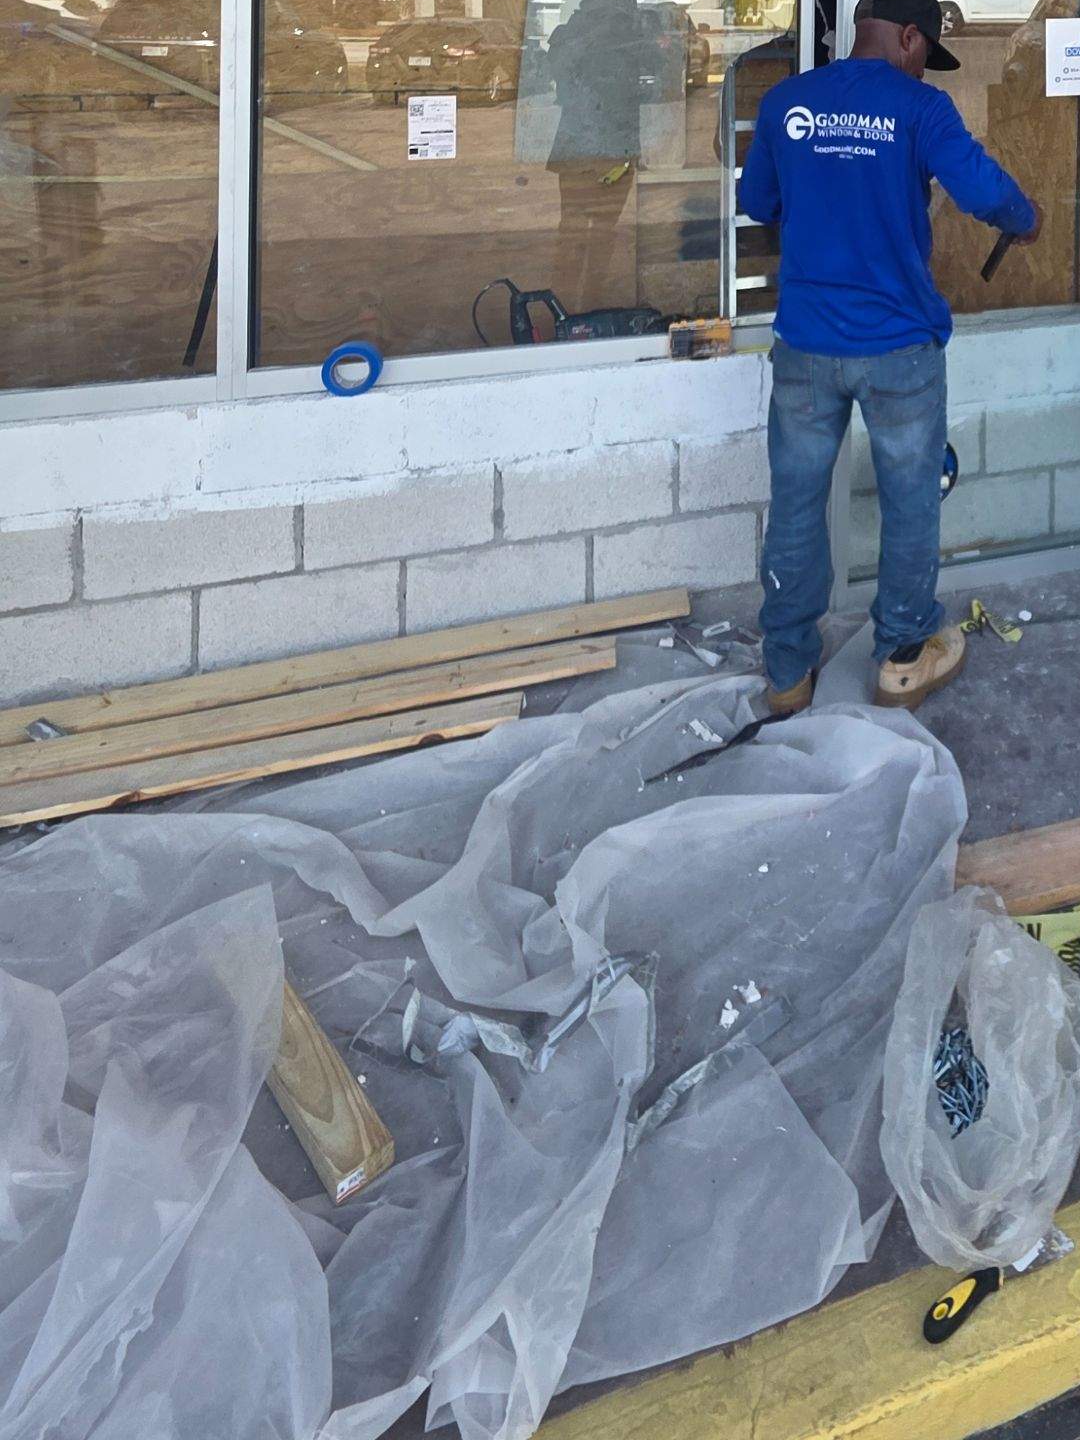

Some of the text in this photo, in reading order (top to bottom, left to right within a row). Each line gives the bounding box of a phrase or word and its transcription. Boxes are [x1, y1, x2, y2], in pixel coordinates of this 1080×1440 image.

[815, 113, 896, 132] GOODMAN
[817, 128, 895, 142] WINDOW & DOOR
